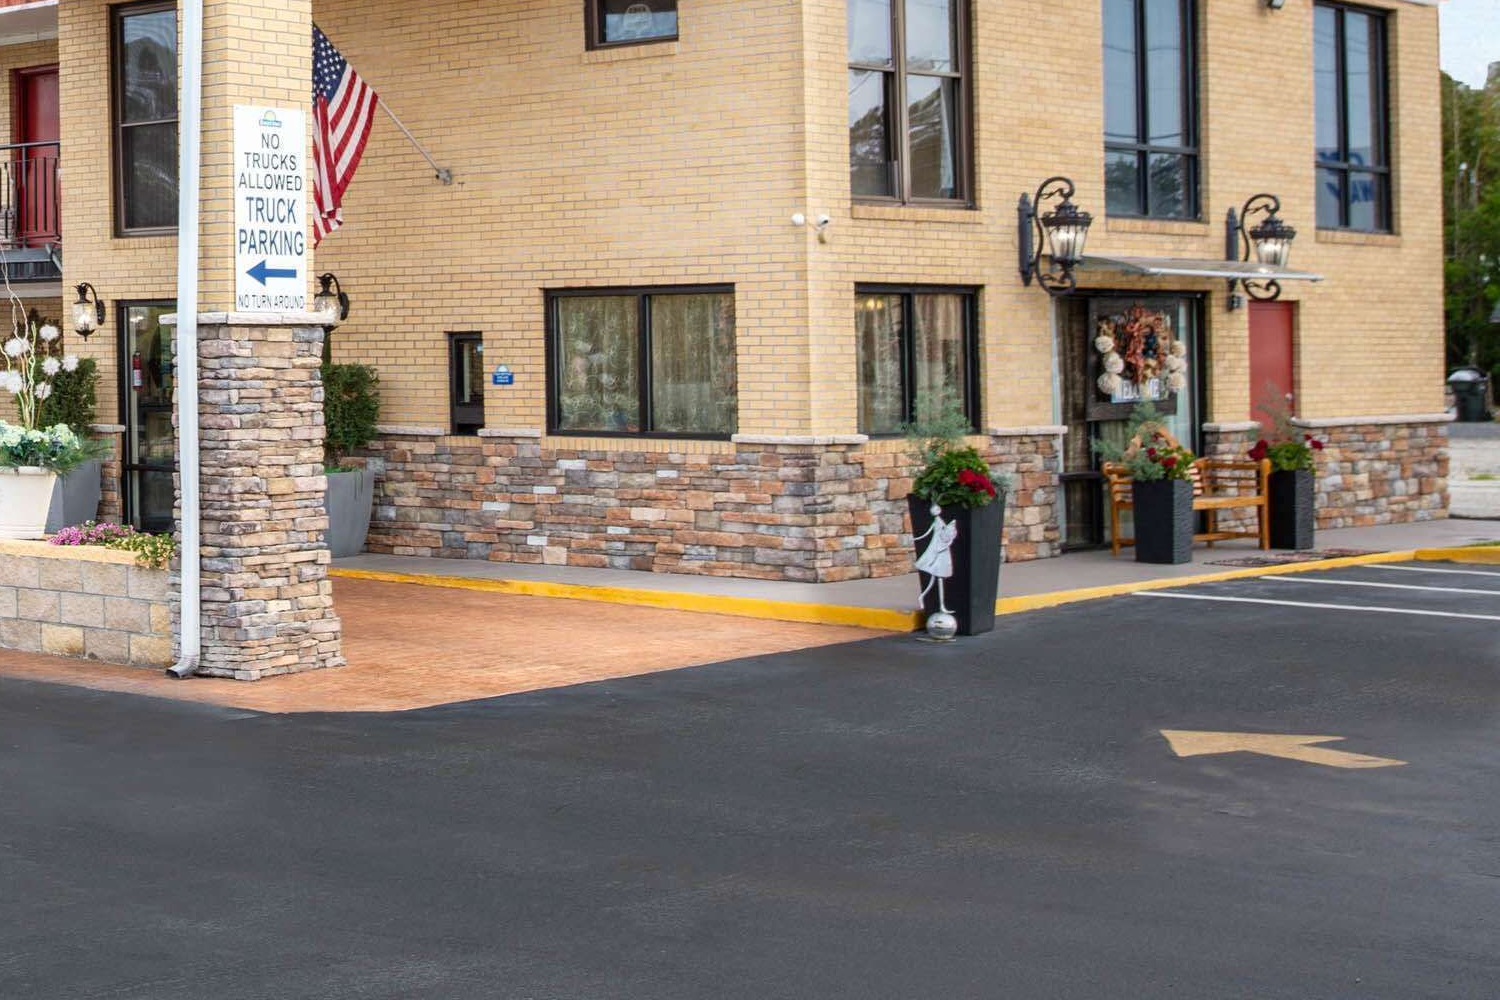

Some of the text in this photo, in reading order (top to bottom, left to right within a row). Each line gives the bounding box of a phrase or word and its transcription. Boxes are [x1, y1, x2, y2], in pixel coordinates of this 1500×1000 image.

[261, 133, 280, 150] NO
[244, 151, 297, 171] TRUCKS
[238, 172, 302, 191] ALLOWED
[245, 196, 297, 224] TRUCK
[238, 228, 304, 257] PARKING
[238, 294, 305, 310] NO TURN AROUND
